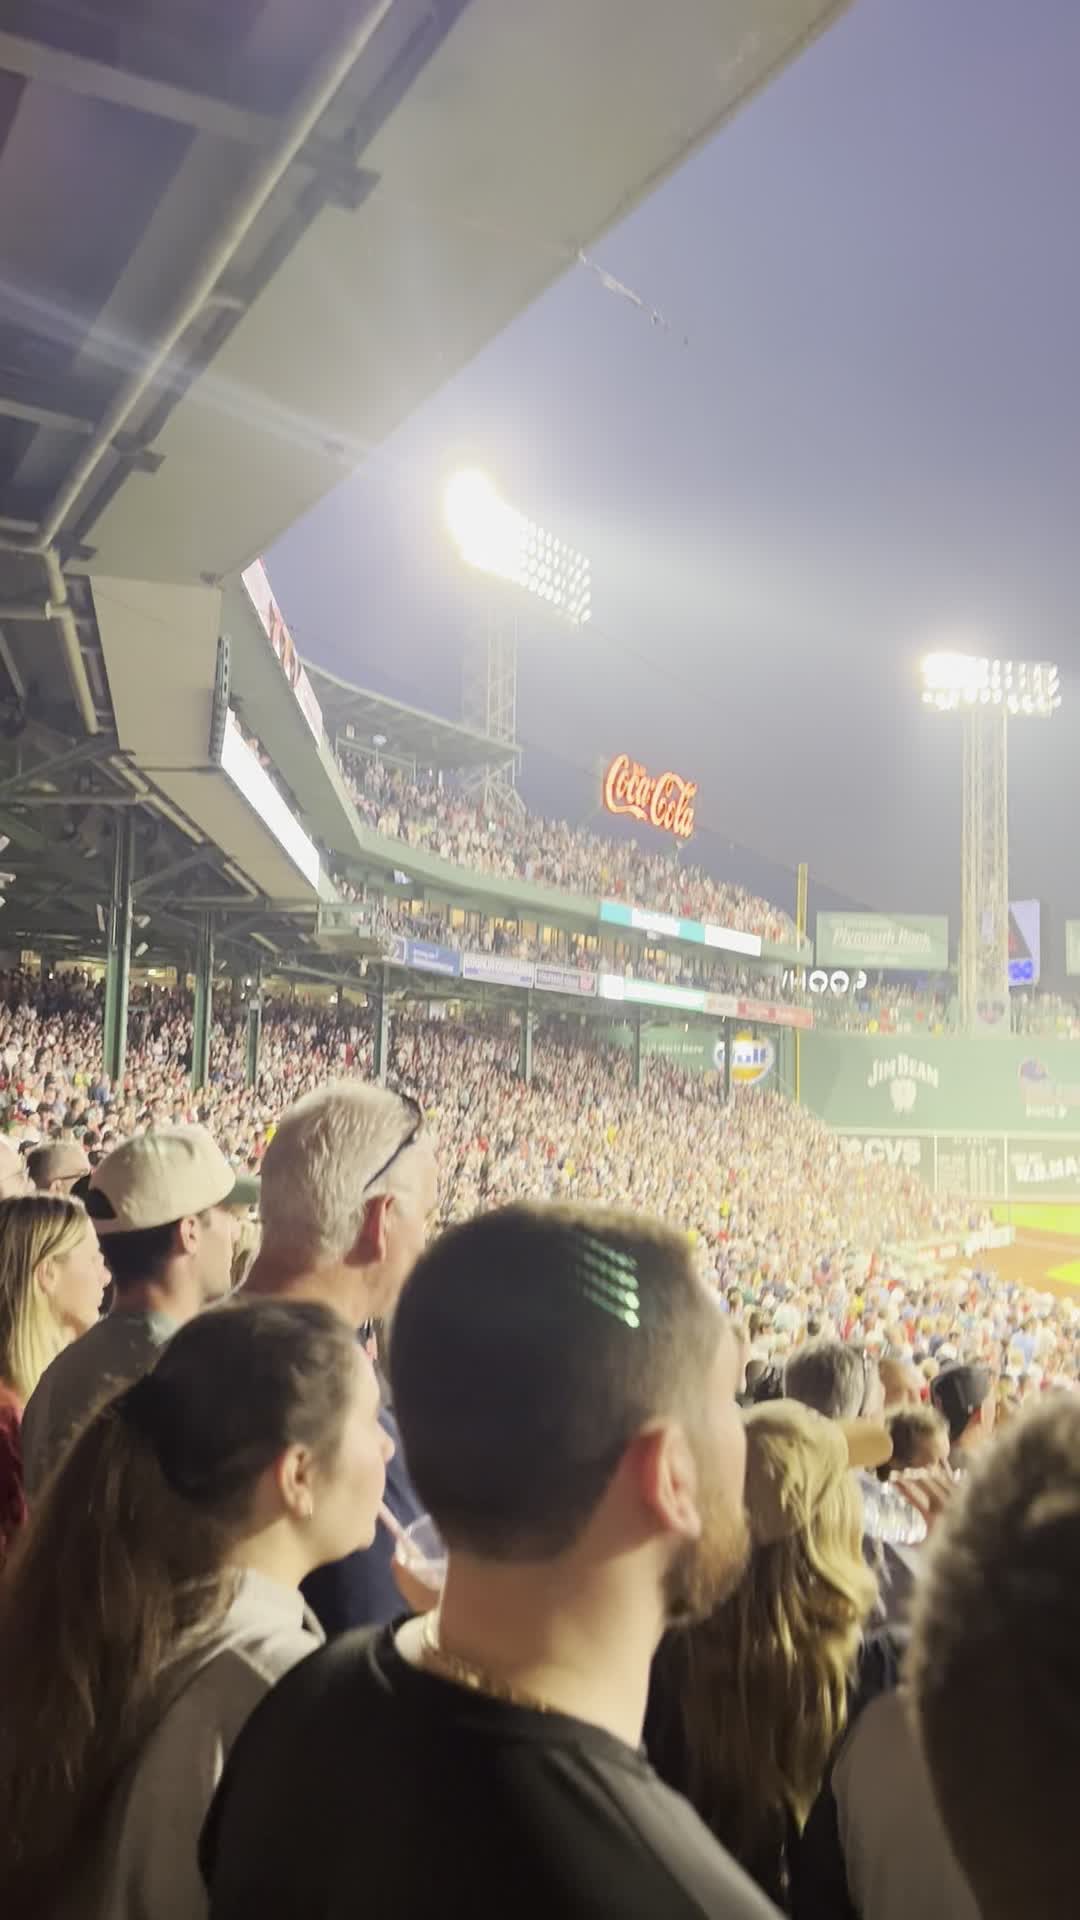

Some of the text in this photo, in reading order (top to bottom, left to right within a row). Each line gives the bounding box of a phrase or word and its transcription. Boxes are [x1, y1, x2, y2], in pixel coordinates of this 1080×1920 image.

[605, 754, 698, 838] Coca-Cola
[867, 1053, 939, 1088] JIM BEAM
[864, 1138, 921, 1167] CVS
